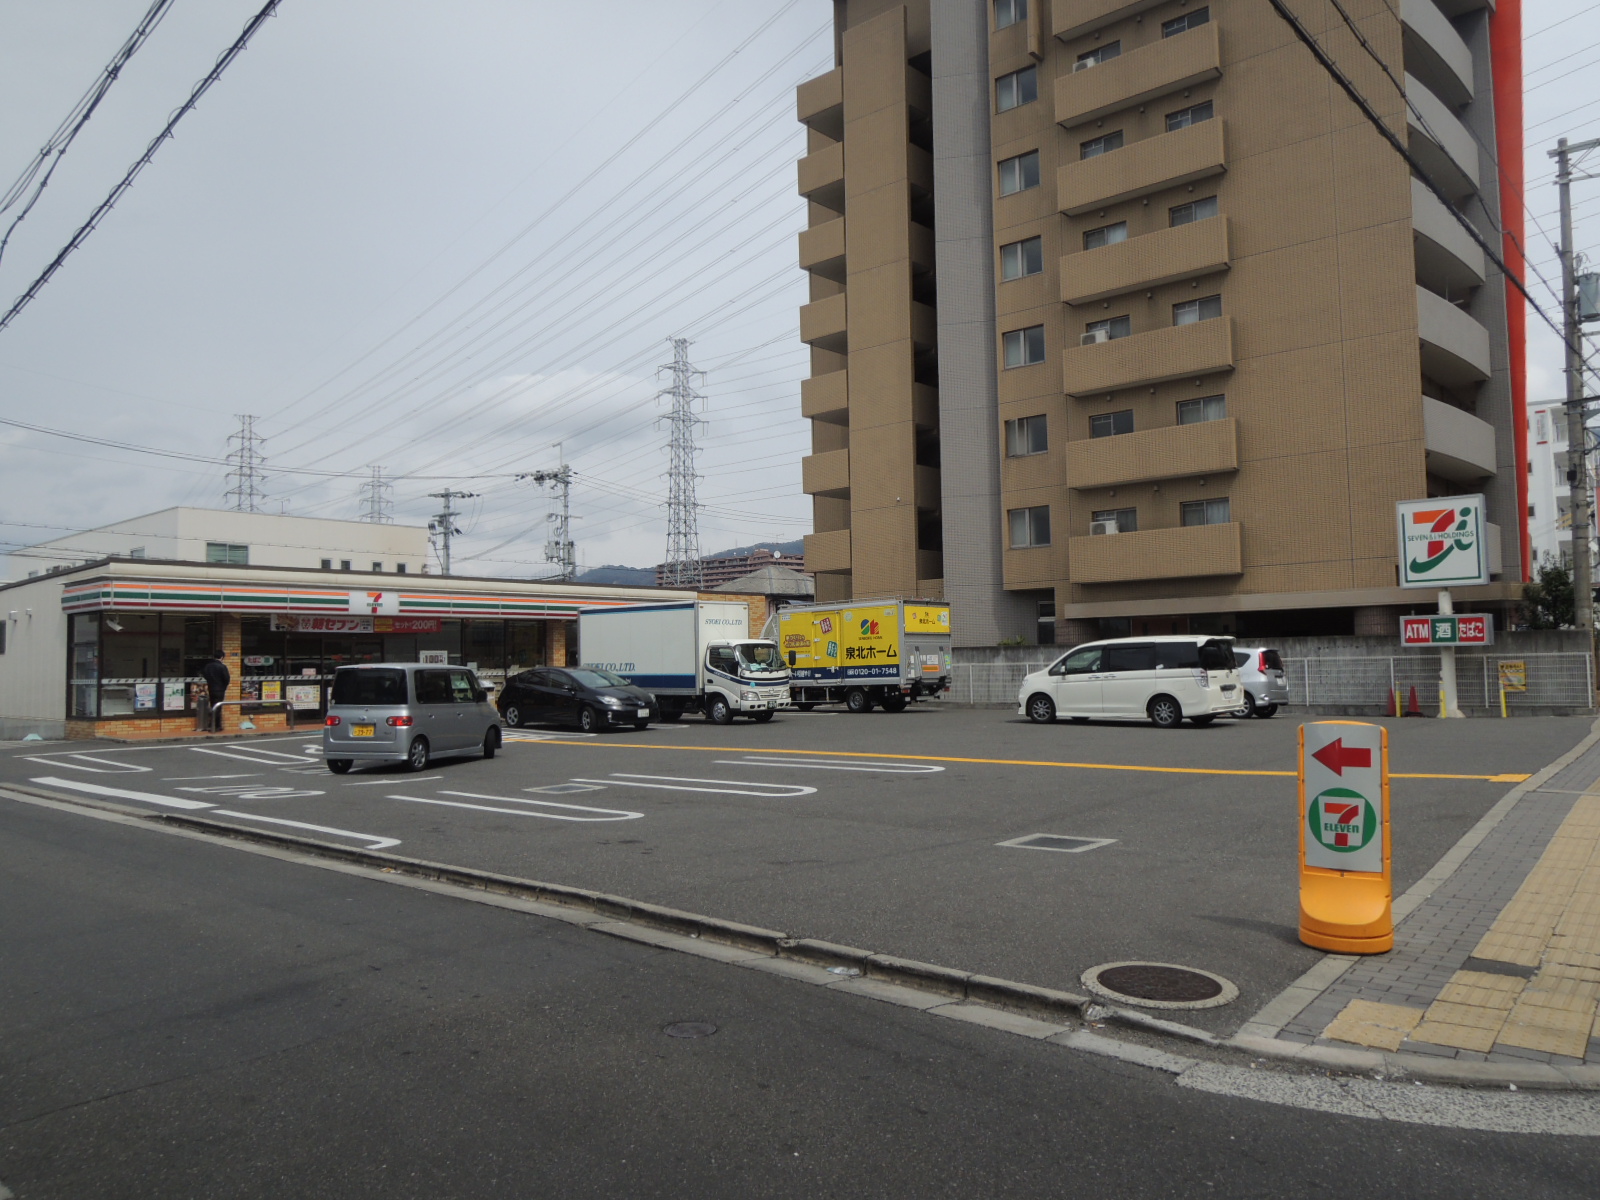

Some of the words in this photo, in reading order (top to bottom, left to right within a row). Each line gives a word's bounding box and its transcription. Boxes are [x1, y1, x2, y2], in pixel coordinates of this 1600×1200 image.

[1407, 534, 1428, 542] SEVEN
[1438, 530, 1475, 540] HOLDINGS
[1406, 624, 1429, 639] ATM
[1435, 622, 1452, 639] 酒
[1458, 621, 1484, 638] たばこ
[845, 644, 897, 660] 泉北ホーム
[855, 667, 897, 675] 0120-01-7548
